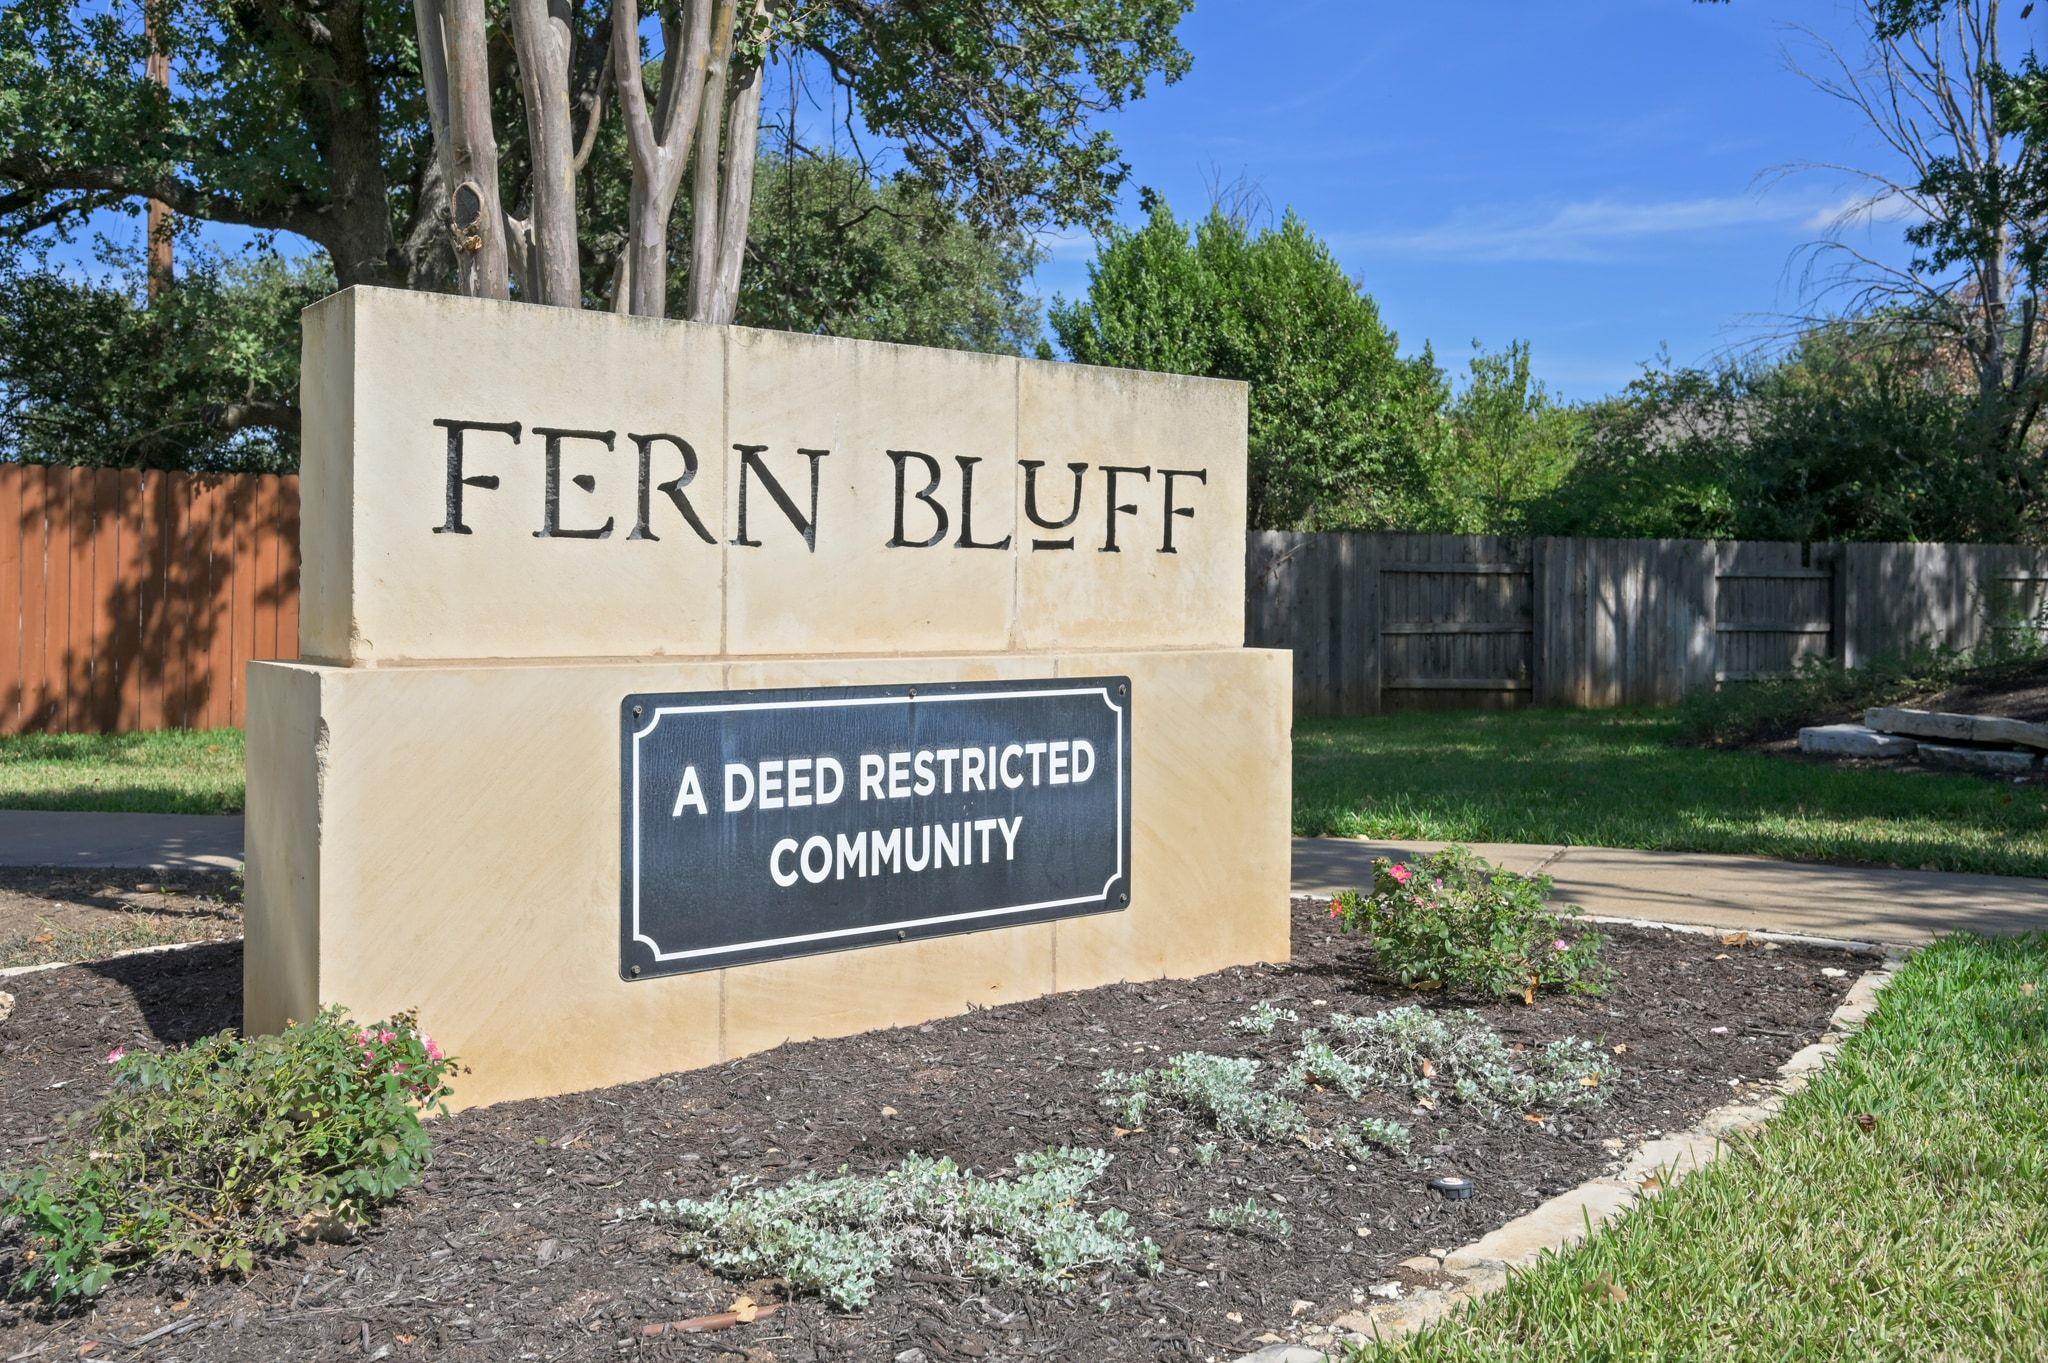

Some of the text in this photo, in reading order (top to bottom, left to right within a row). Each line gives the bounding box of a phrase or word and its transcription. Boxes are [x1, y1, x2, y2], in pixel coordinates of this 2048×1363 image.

[433, 418, 1207, 554] FERN BLUFF
[671, 739, 1096, 818] A DEED RESTRICTED
[769, 815, 1024, 888] COMMUNITY
